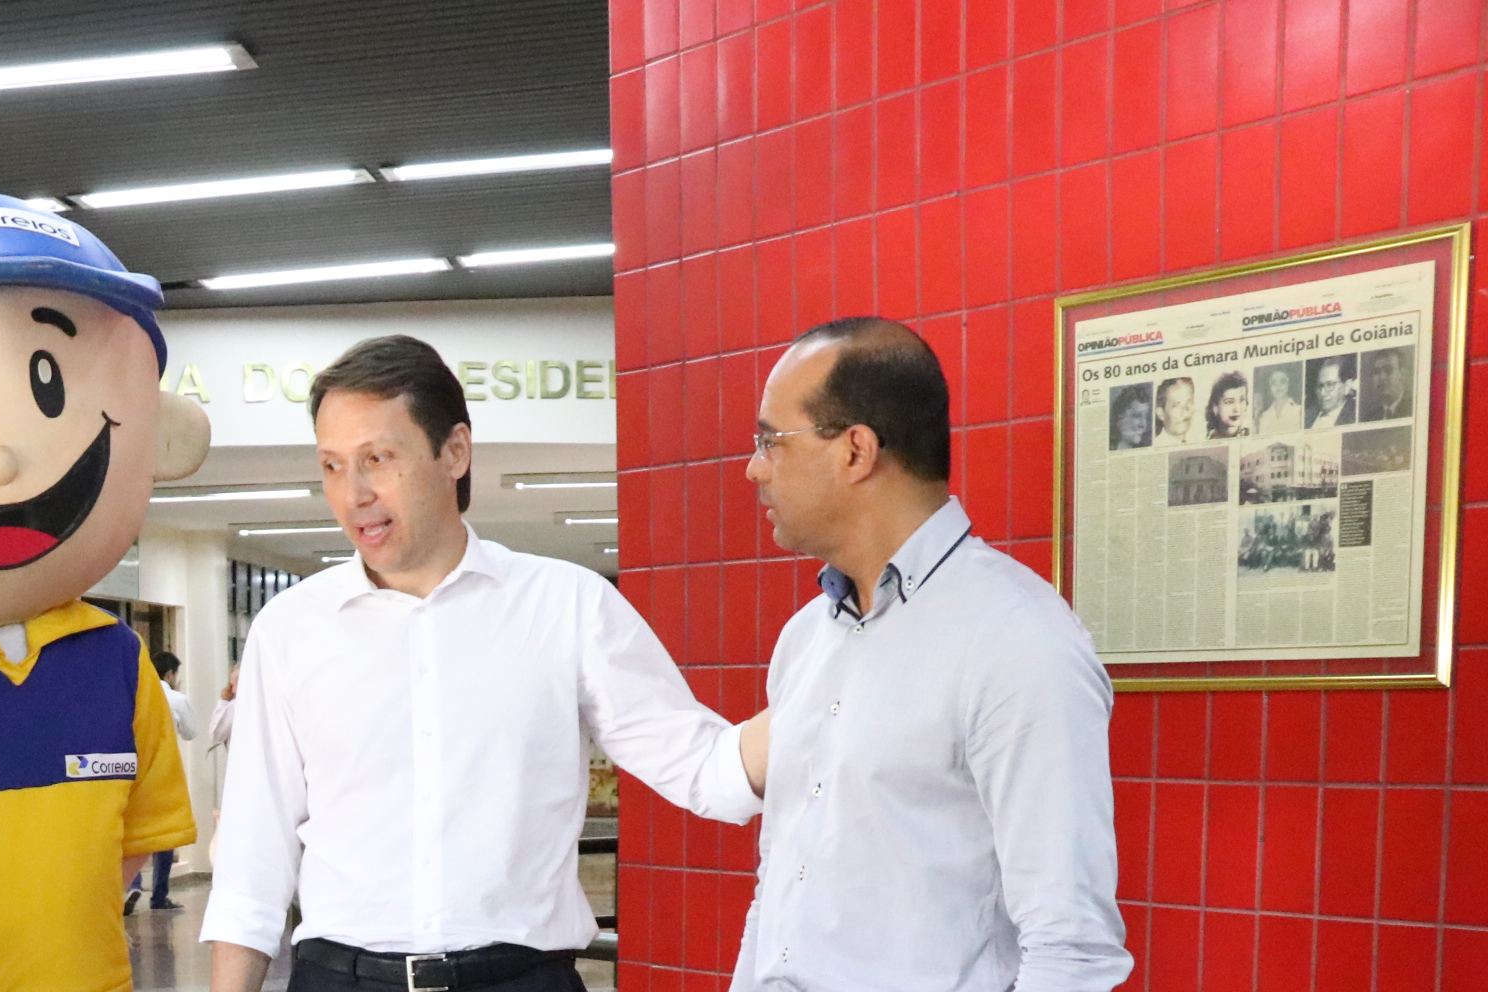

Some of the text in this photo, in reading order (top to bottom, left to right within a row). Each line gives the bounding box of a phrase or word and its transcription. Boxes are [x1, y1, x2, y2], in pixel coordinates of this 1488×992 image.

[1082, 322, 1413, 382] Os 80 anos da Câmara Municipal de Goiânia
[92, 761, 135, 774] Correios
